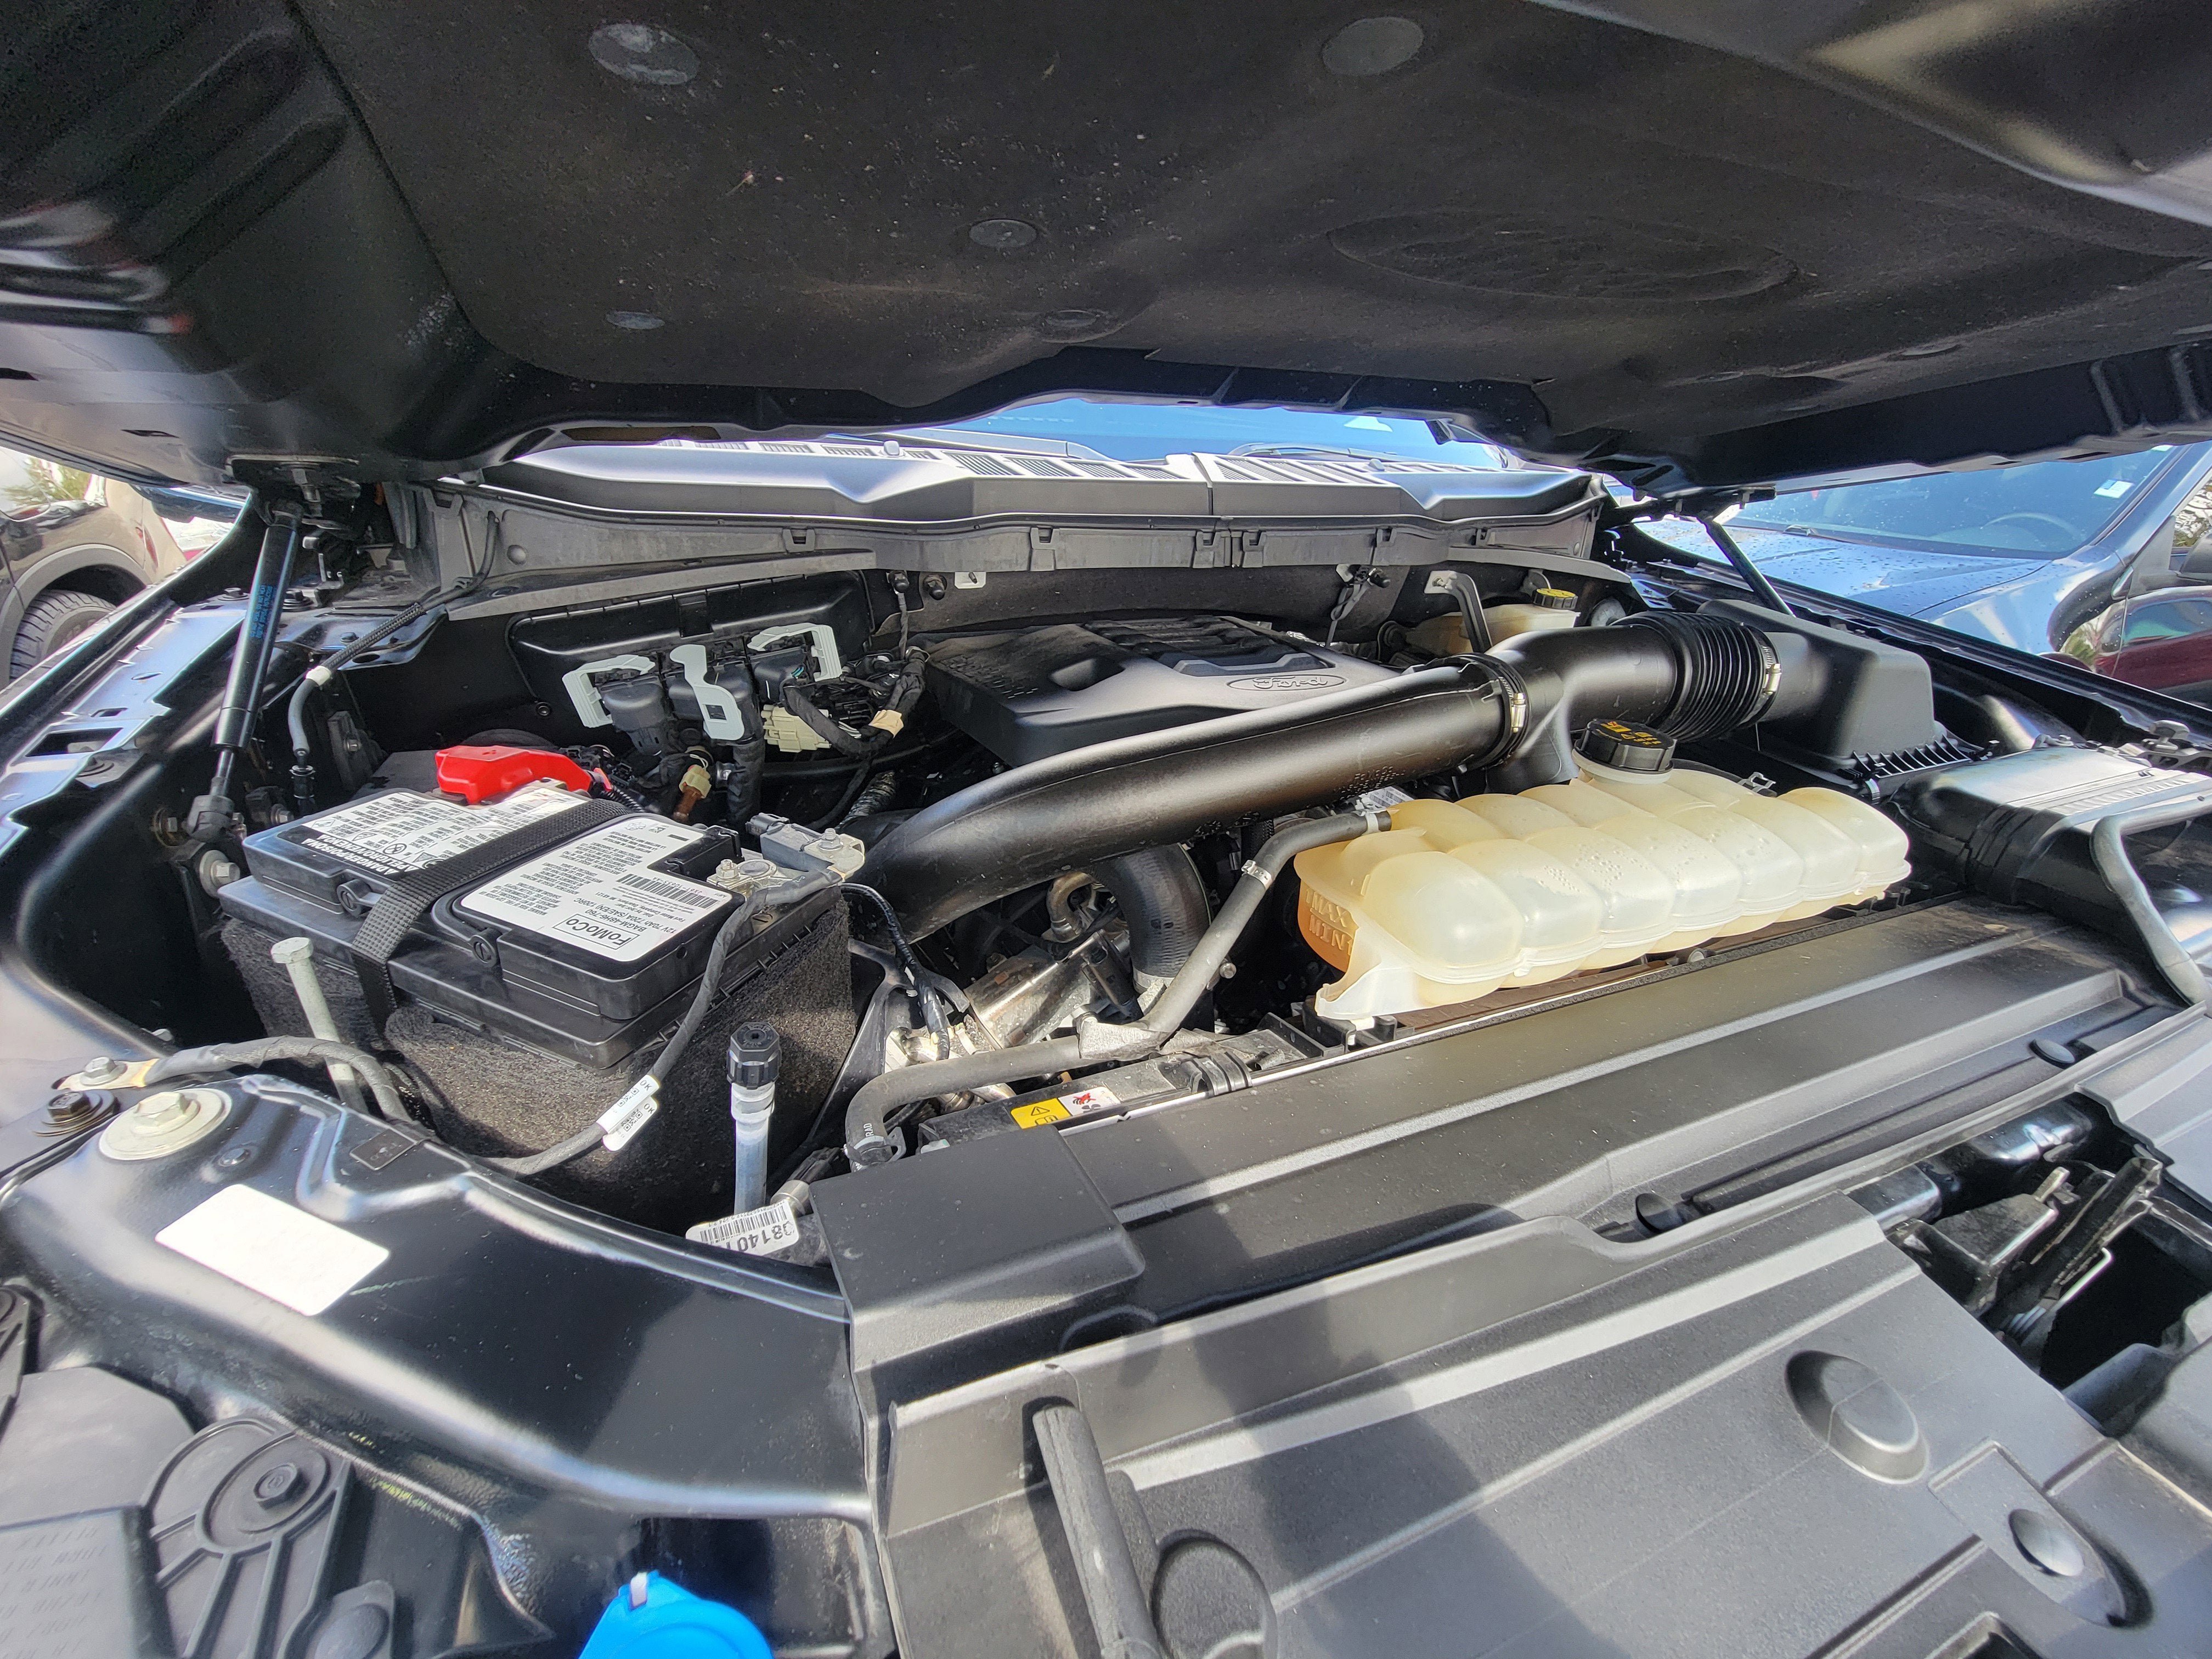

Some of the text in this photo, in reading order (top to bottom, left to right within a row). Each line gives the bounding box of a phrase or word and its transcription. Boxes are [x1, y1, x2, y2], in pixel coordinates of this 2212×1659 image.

[1252, 676, 1328, 689] Ford
[572, 898, 598, 907] 120RC
[594, 904, 630, 917] (SAE/EN)
[1312, 891, 1347, 928] MAX
[583, 909, 647, 932] BAGM-48H6-760
[624, 915, 646, 923] 720A
[643, 921, 663, 929] 70Ah
[562, 918, 632, 945] FoMoCo
[1309, 915, 1345, 950] MIN
[640, 1080, 652, 1091] OK
[644, 1103, 656, 1114] OK
[863, 1123, 874, 1137] RAD
